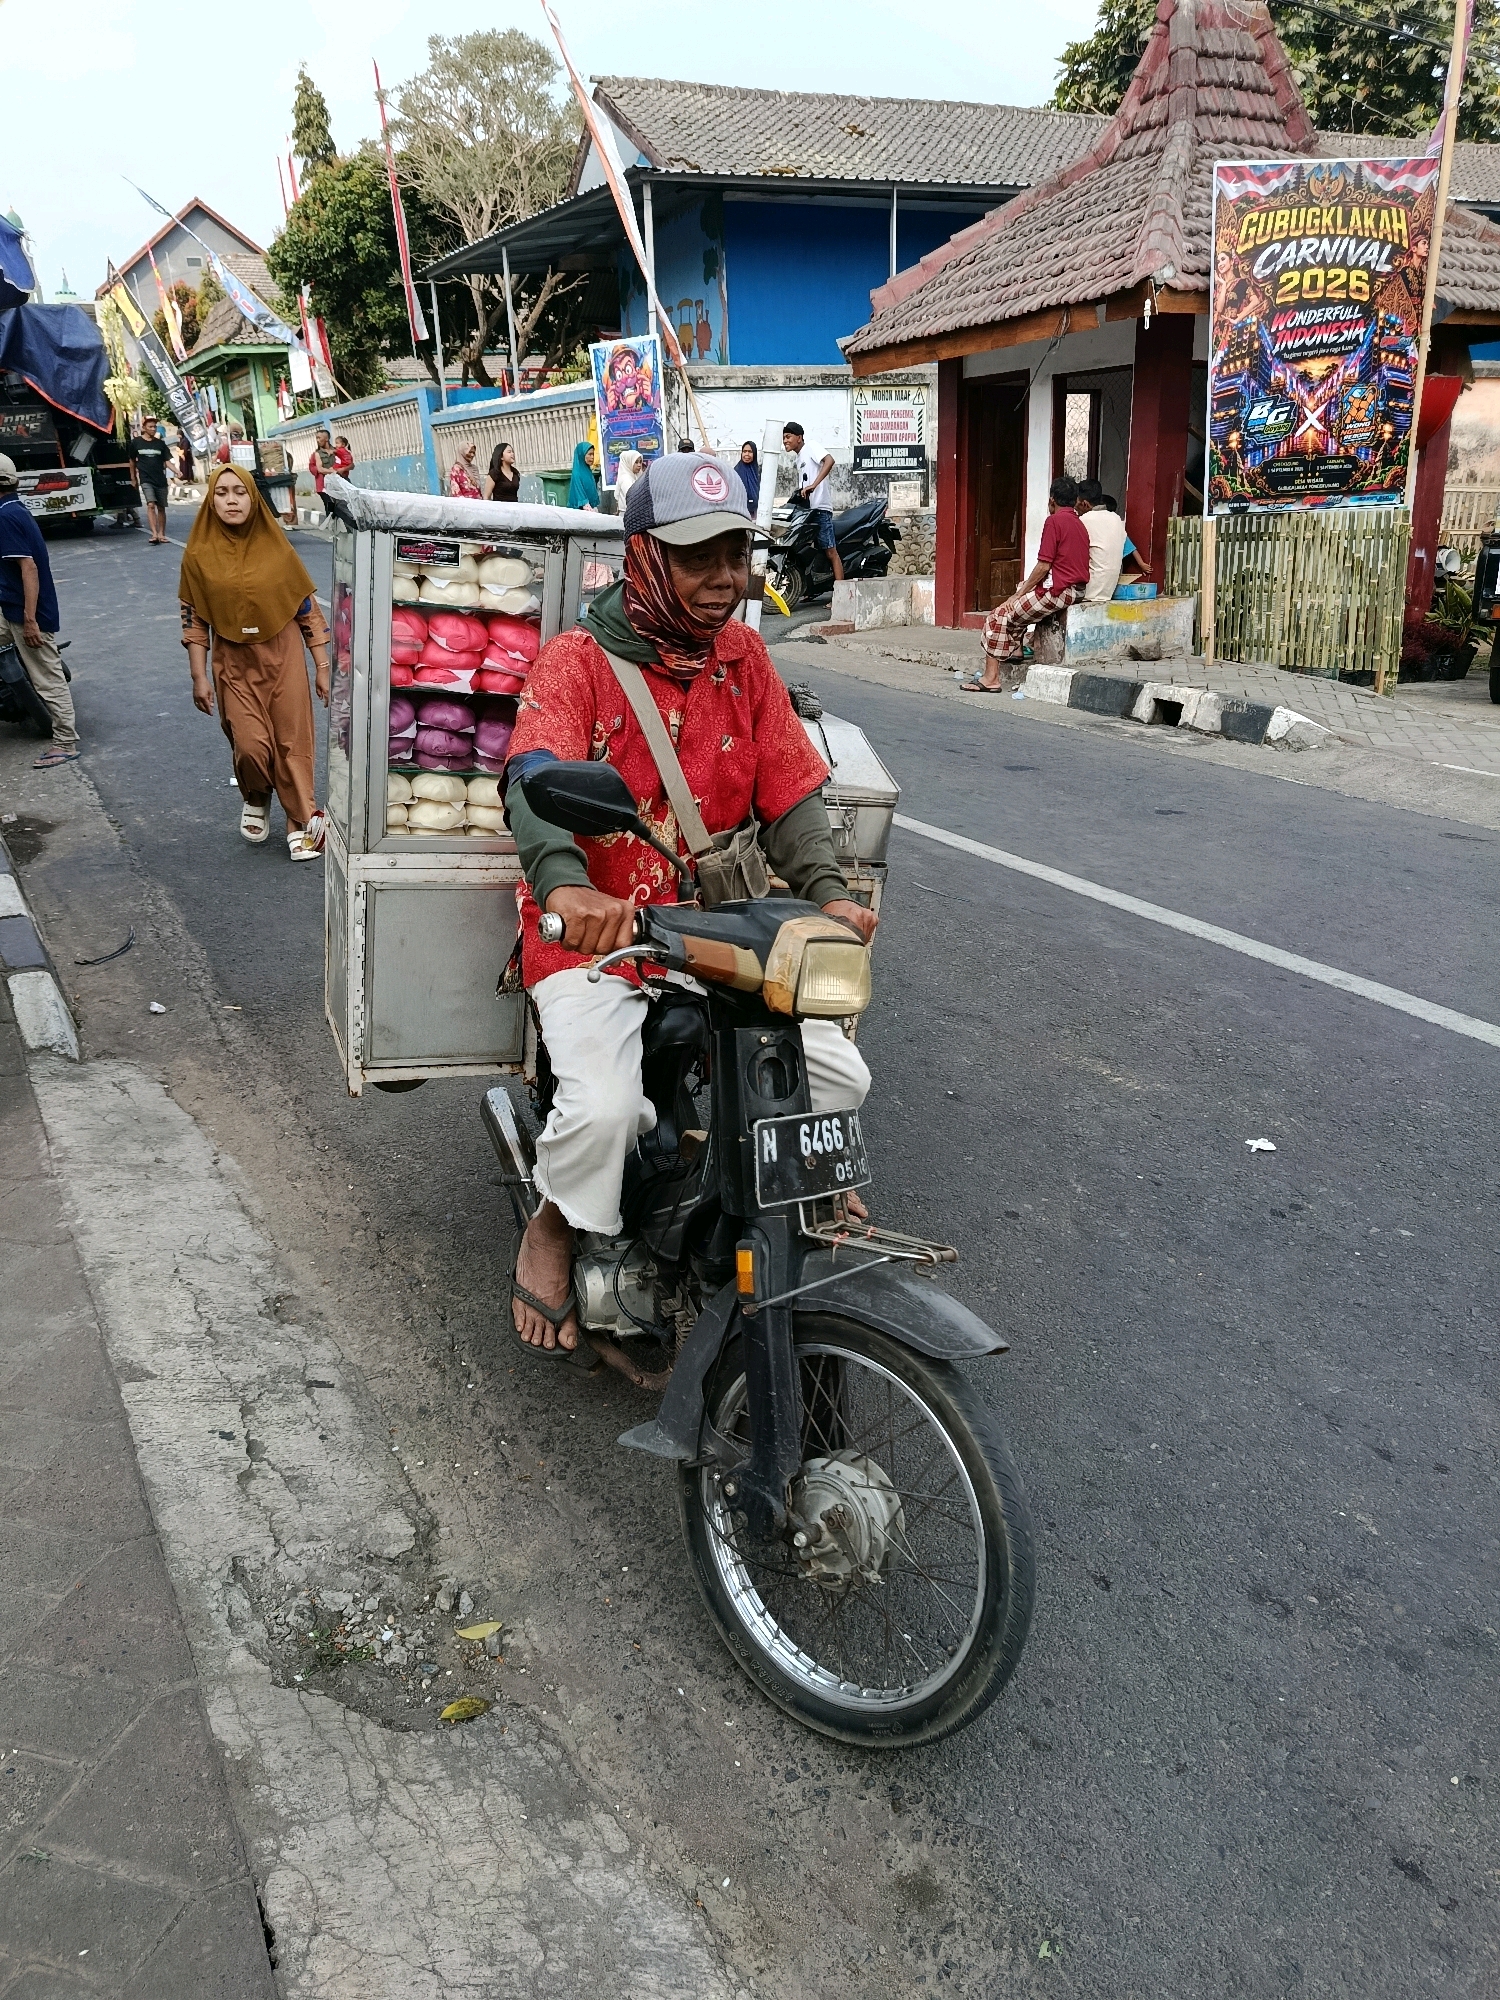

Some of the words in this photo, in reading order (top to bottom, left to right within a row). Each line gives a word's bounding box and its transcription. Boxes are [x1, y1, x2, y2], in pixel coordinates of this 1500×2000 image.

[1236, 206, 1410, 253] GUBUGKLAKAH
[1252, 237, 1394, 279] CARNIVAL
[1275, 268, 1370, 304] 2026
[1271, 305, 1362, 332] WONDERFULL
[1272, 318, 1366, 355] INDONESIA
[871, 390, 893, 401] MOHON
[894, 390, 911, 401] MAAF
[870, 422, 879, 430] DAN
[762, 1128, 777, 1163] N
[800, 1117, 844, 1157] 6466
[729, 1632, 751, 1657] PRO
